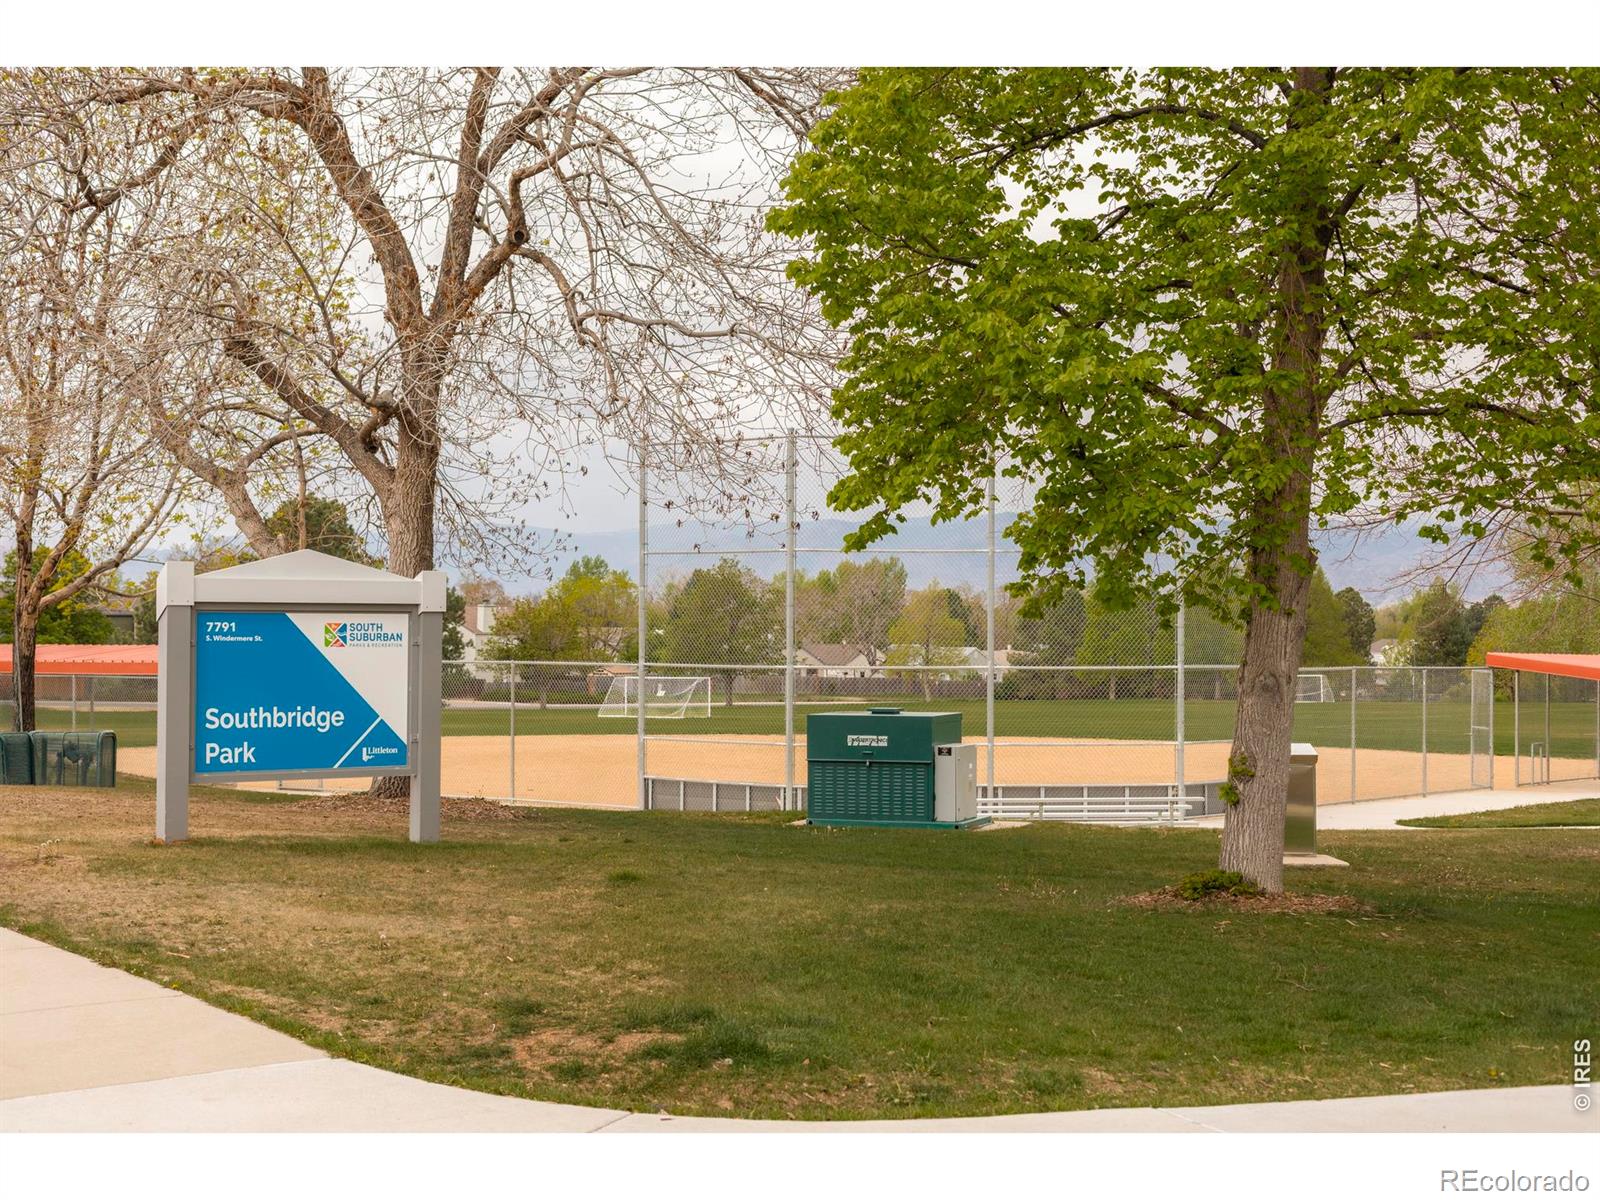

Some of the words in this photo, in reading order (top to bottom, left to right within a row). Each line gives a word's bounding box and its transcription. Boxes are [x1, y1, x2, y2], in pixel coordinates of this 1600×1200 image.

[206, 622, 237, 632] 7791
[349, 623, 383, 632] SOUTH
[349, 633, 403, 641] SUBURBAN
[205, 705, 345, 733] Southbridge
[205, 742, 256, 764] Park
[368, 746, 398, 754] Littleton
